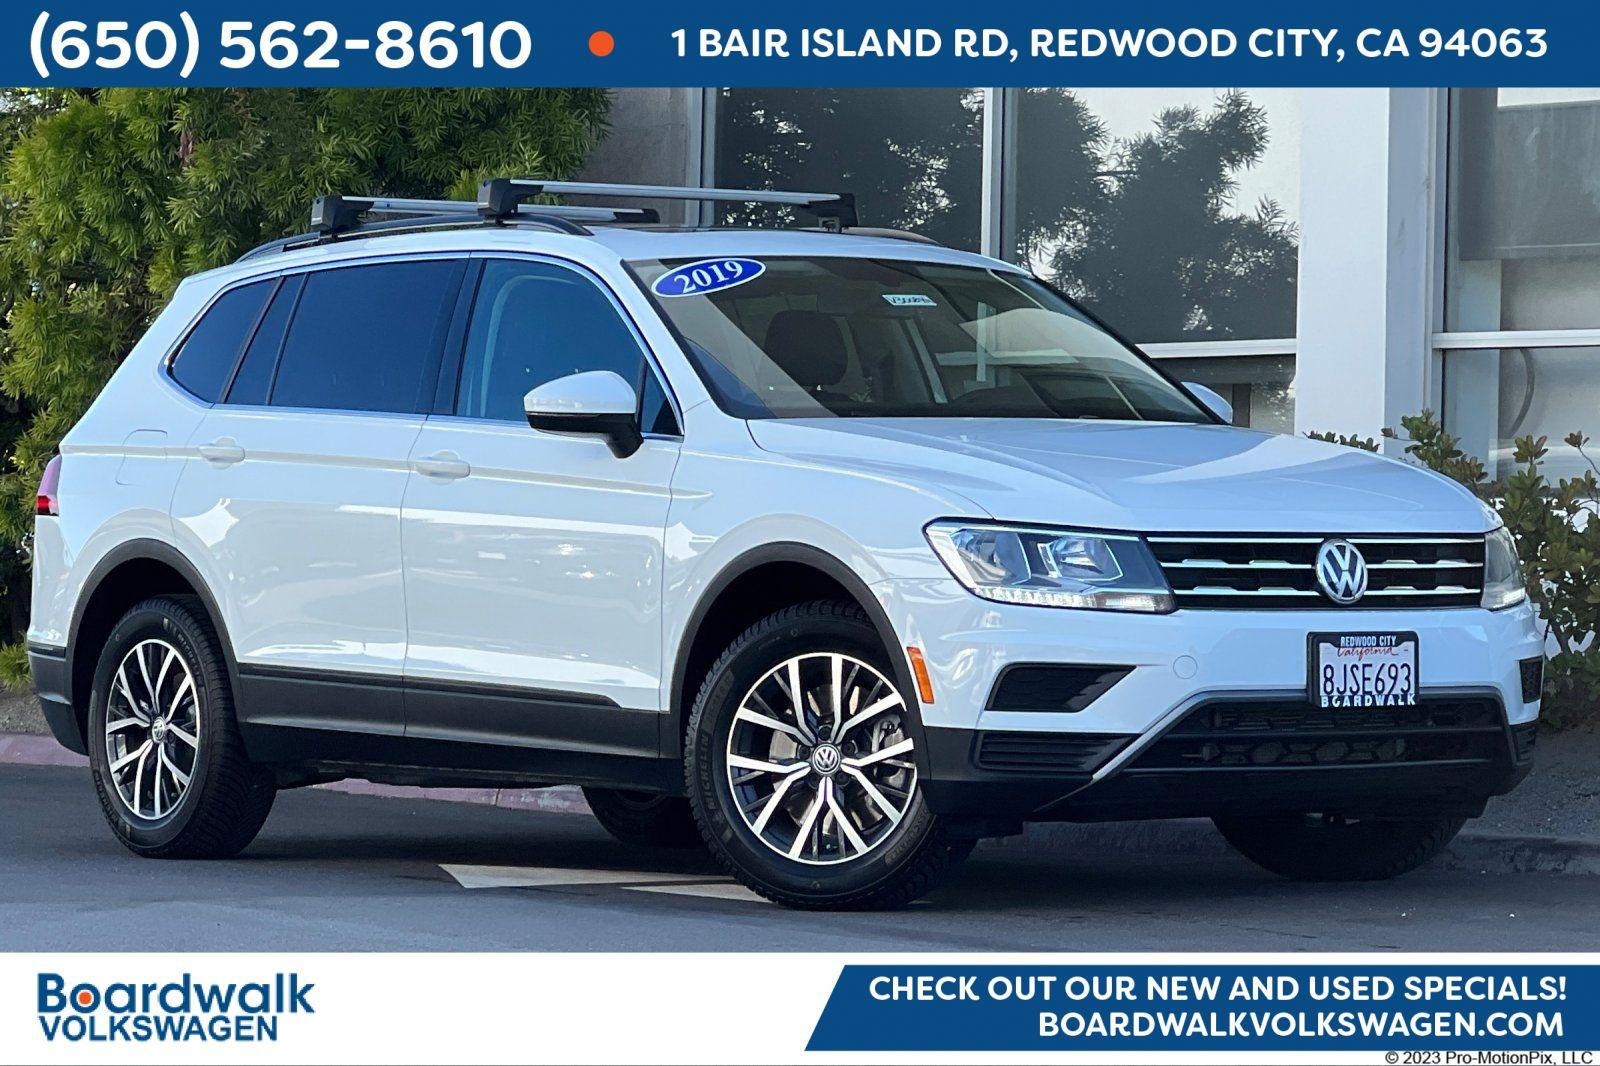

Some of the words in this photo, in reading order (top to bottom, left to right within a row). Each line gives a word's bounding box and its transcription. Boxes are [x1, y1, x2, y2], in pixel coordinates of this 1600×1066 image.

[674, 260, 743, 294] 2019
[1340, 636, 1376, 647] REDWOOD
[1379, 635, 1397, 646] CITY
[1337, 647, 1398, 661] California
[1323, 662, 1411, 695] 8JSE693
[1321, 693, 1416, 708] BOARDWALK
